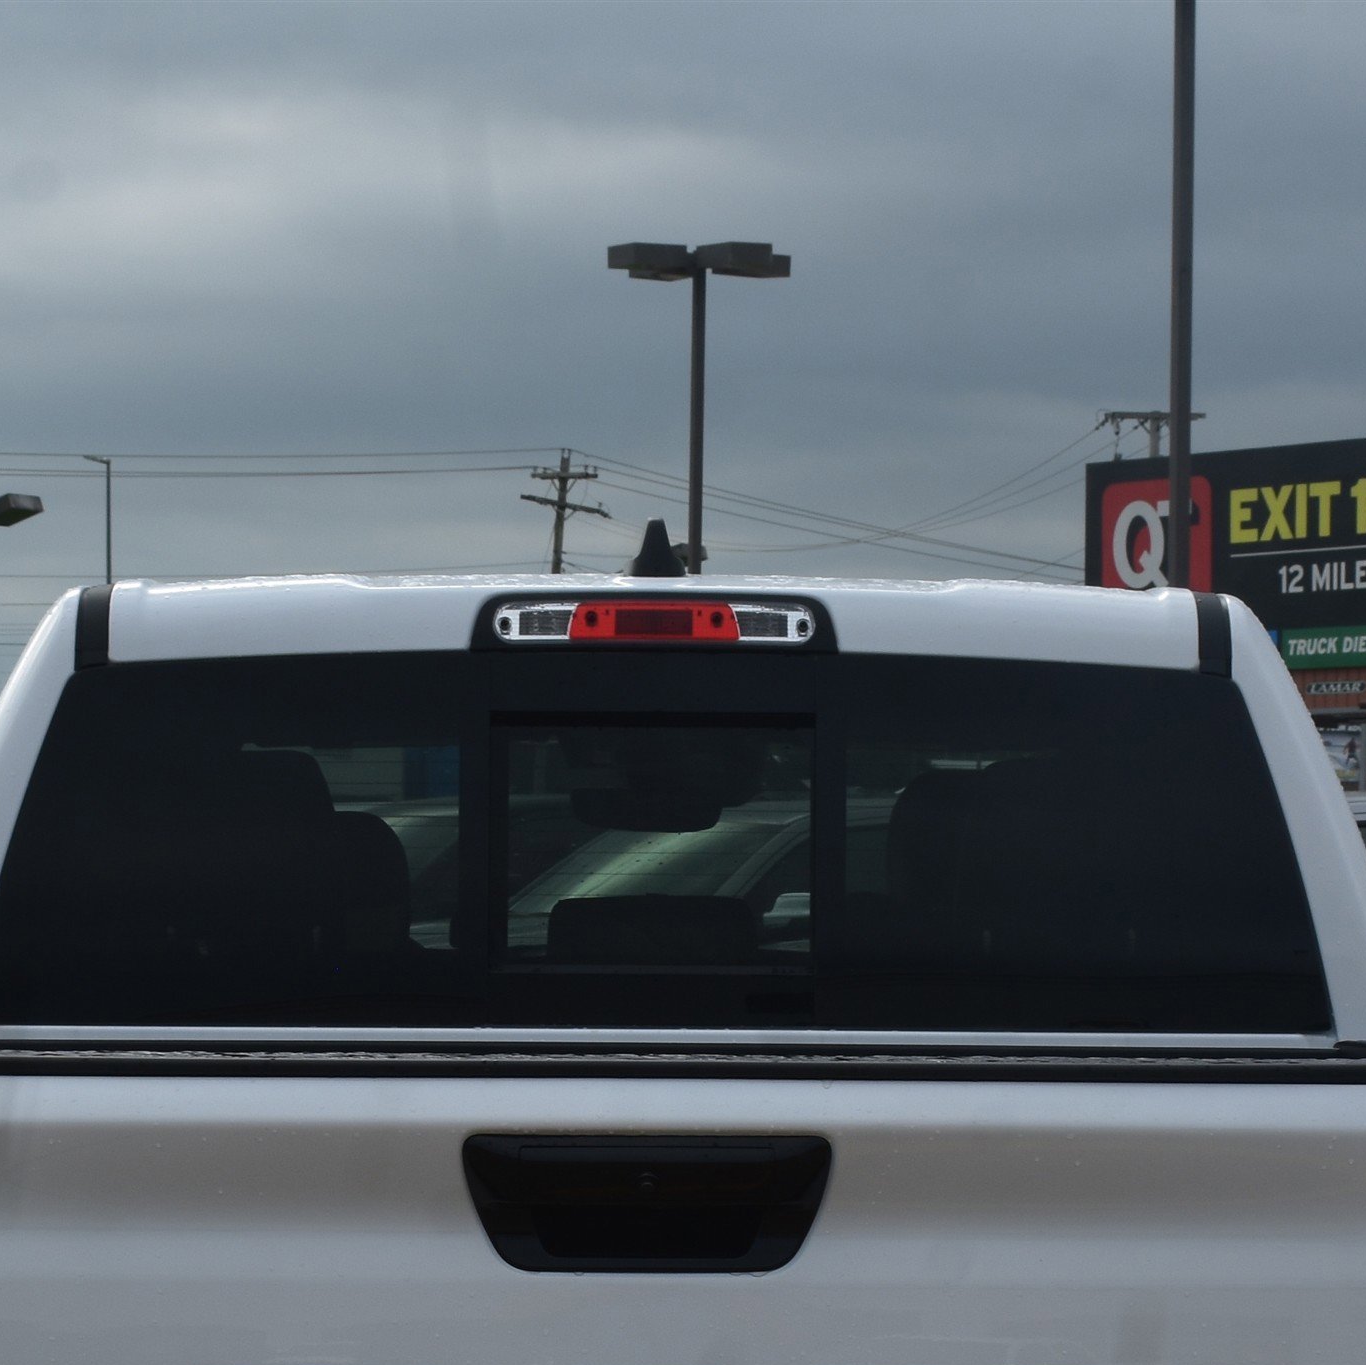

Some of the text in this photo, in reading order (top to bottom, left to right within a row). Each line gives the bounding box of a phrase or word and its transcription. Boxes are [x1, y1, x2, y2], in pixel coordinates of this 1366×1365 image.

[1230, 481, 1341, 543] EXIT
[1279, 565, 1304, 593] 12
[1288, 637, 1337, 656] TRUCK
[1310, 681, 1361, 694] LAMAR
